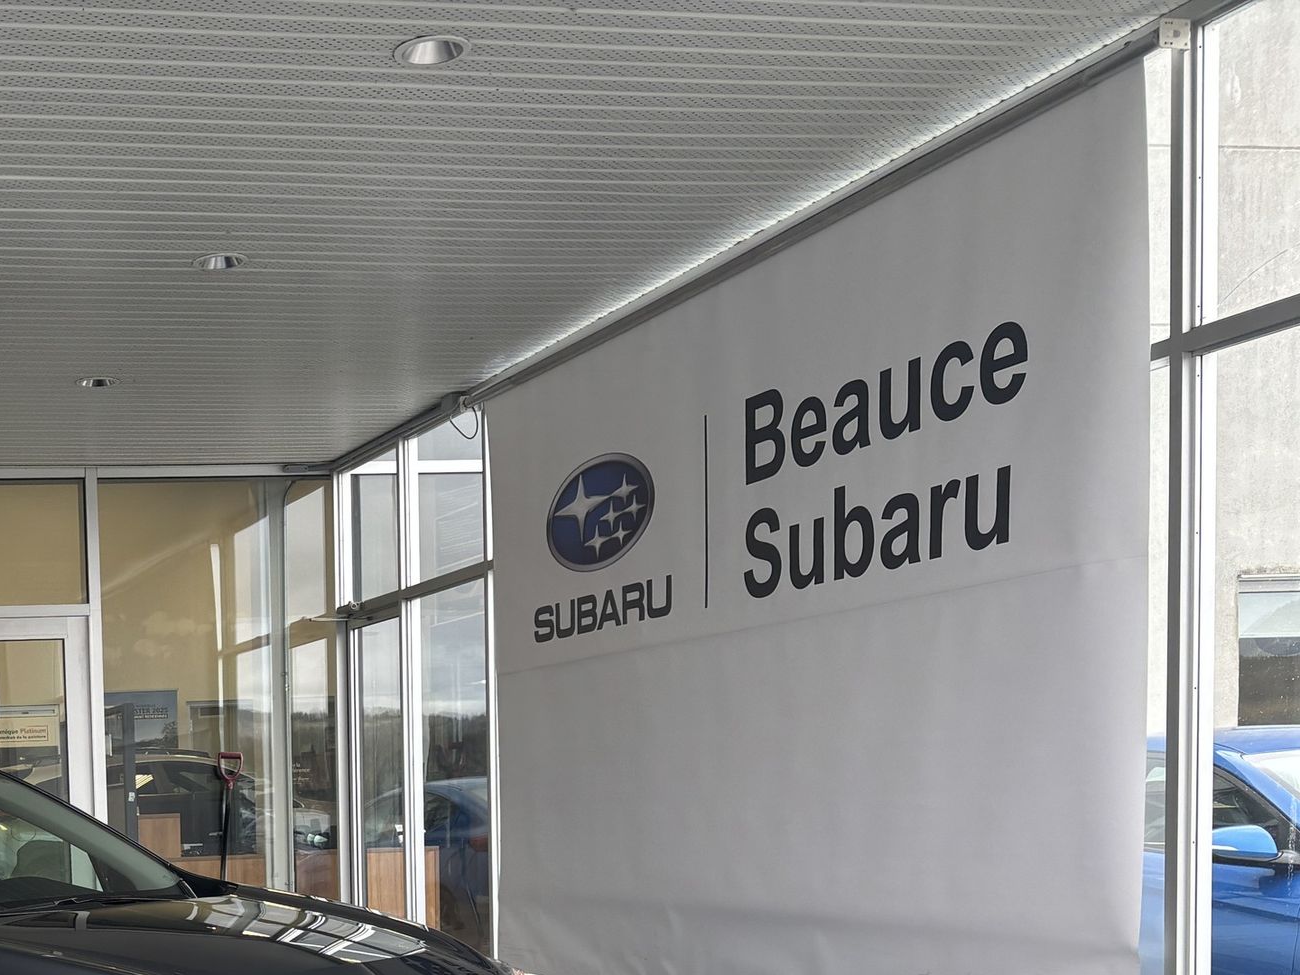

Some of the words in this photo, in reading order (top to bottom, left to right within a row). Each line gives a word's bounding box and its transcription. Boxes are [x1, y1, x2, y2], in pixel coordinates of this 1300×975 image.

[745, 320, 1029, 485] Beauce
[743, 464, 1012, 599] Subaru
[534, 574, 673, 643] SUBARU
